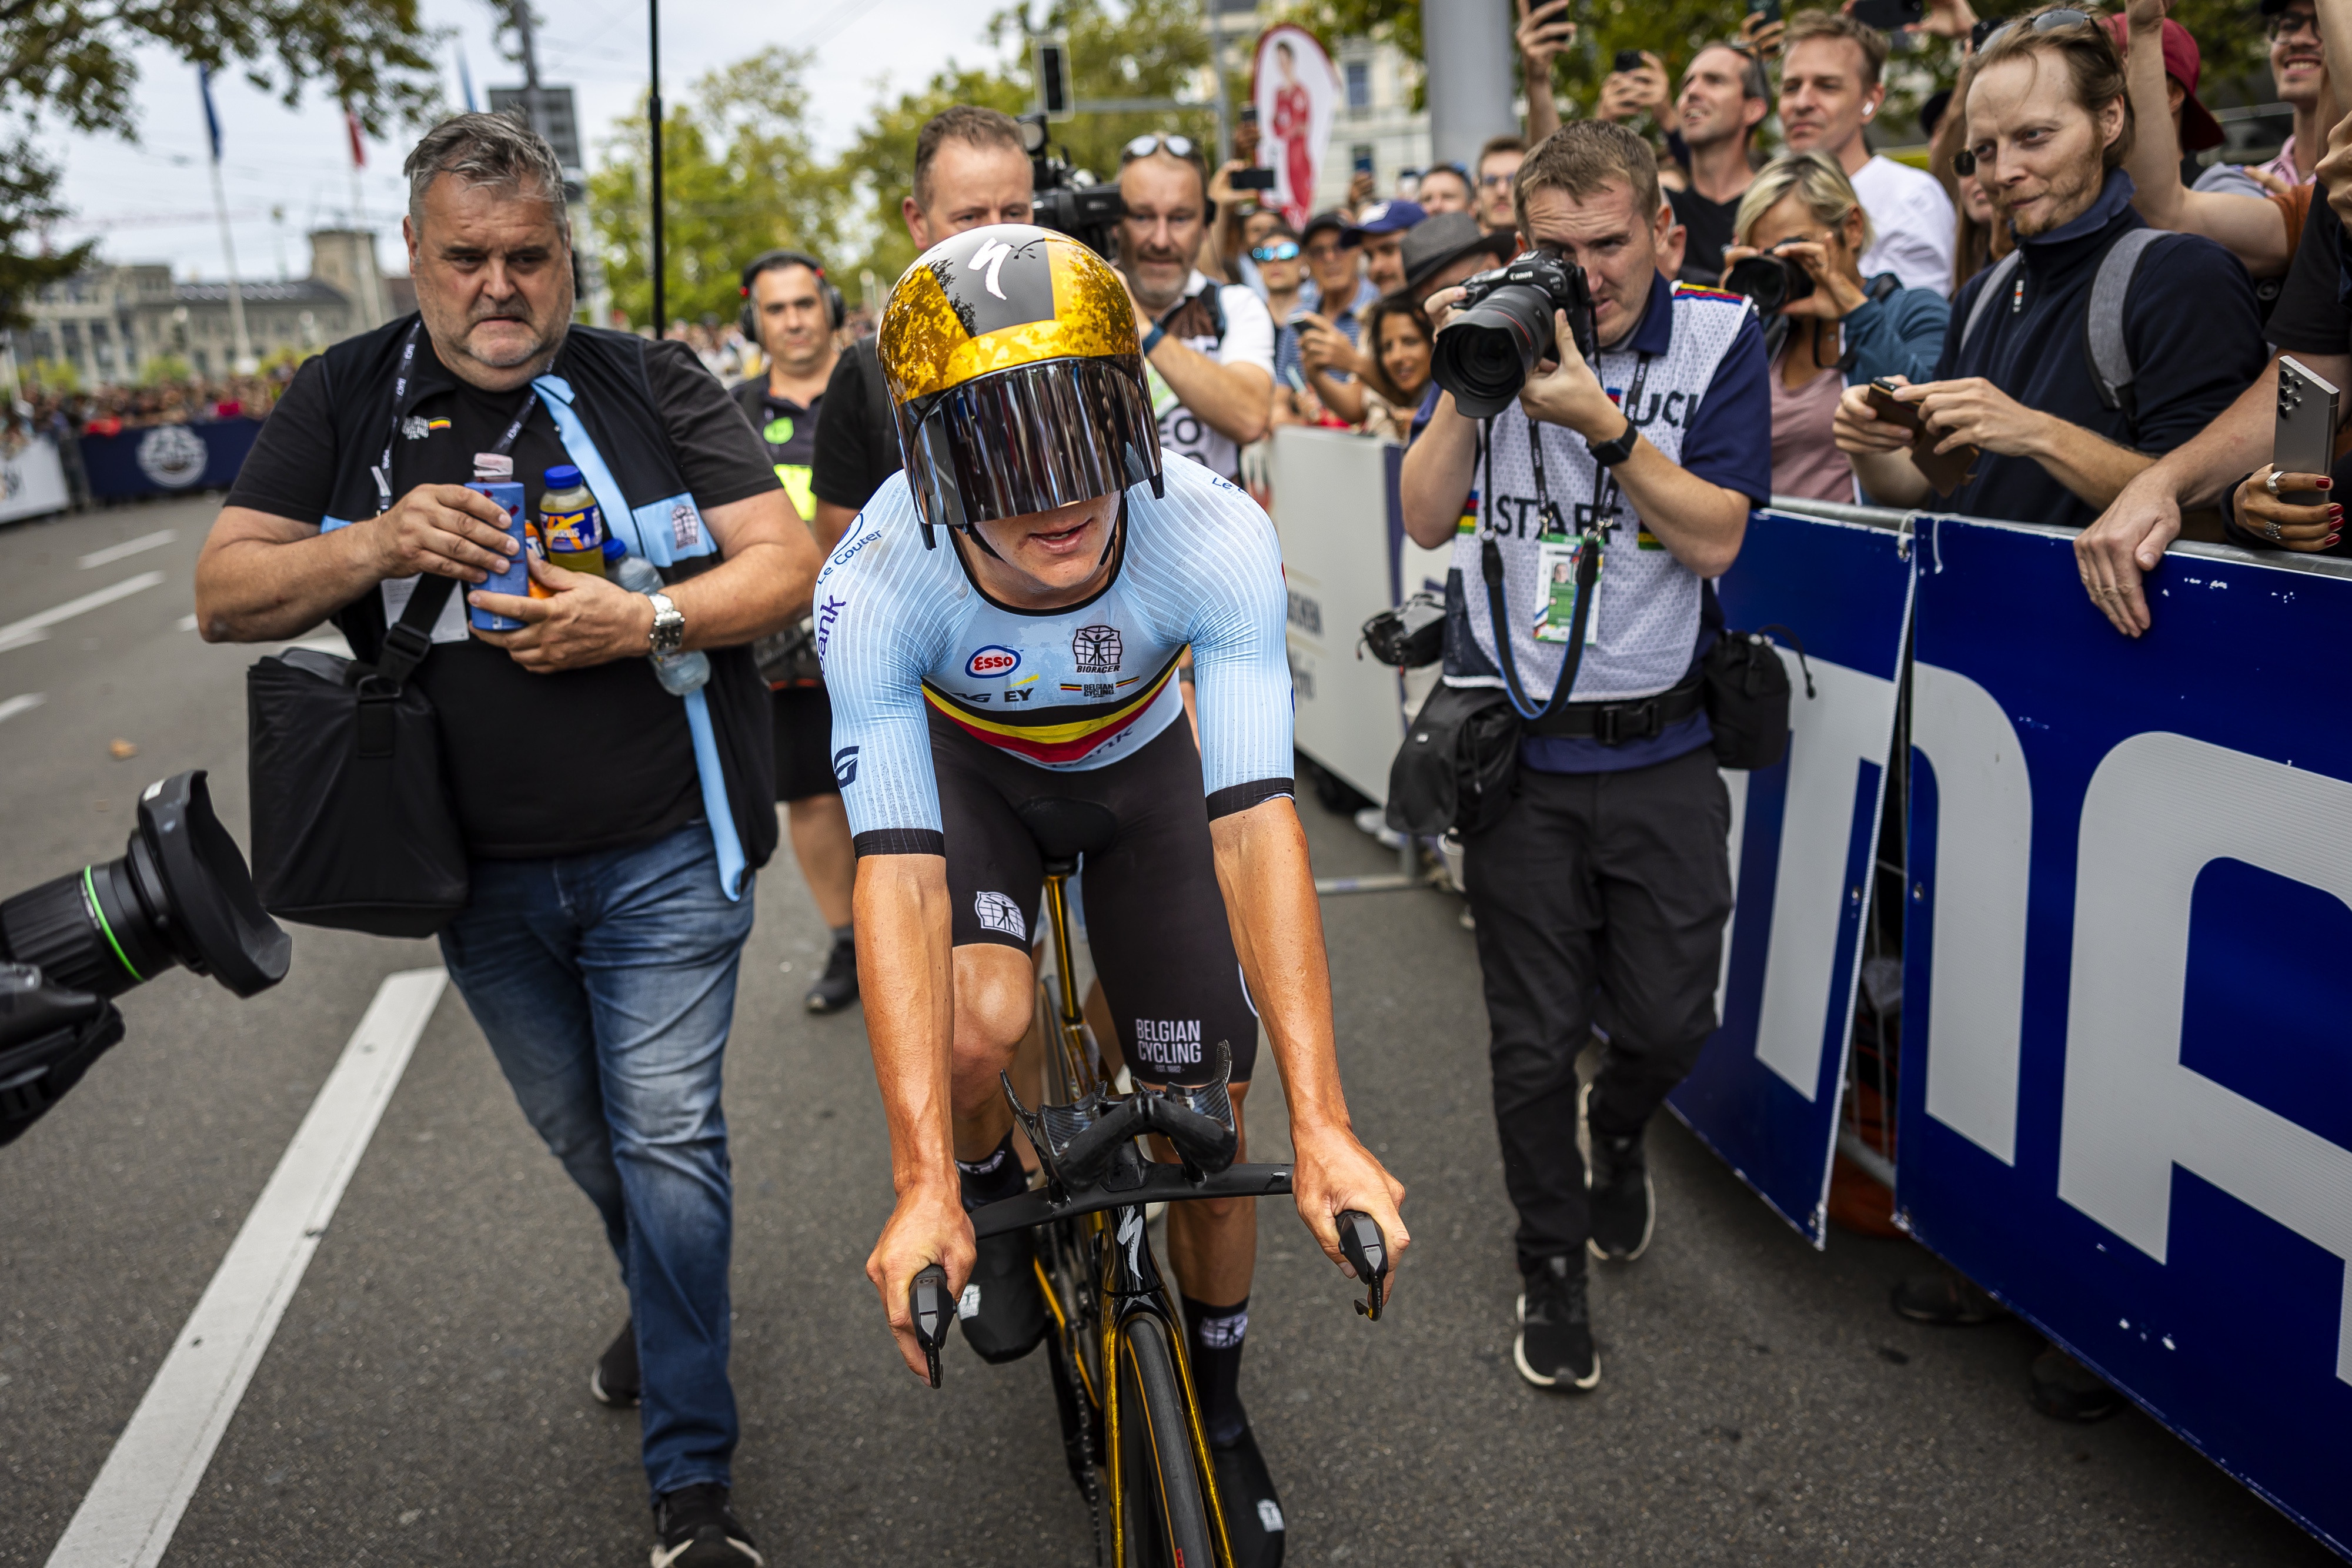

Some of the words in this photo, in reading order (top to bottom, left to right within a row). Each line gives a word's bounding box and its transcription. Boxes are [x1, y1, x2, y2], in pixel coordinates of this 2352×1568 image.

[1509, 270, 1534, 280] Canon
[1633, 391, 1699, 429] UCI
[1212, 477, 1232, 489] Le
[817, 567, 833, 584] Le
[834, 530, 881, 564] Couter
[1077, 665, 1120, 673] BIORACER
[1004, 687, 1034, 703] EY
[1135, 1019, 1201, 1042] BELGIAN
[1138, 1041, 1201, 1064] CYCLING
